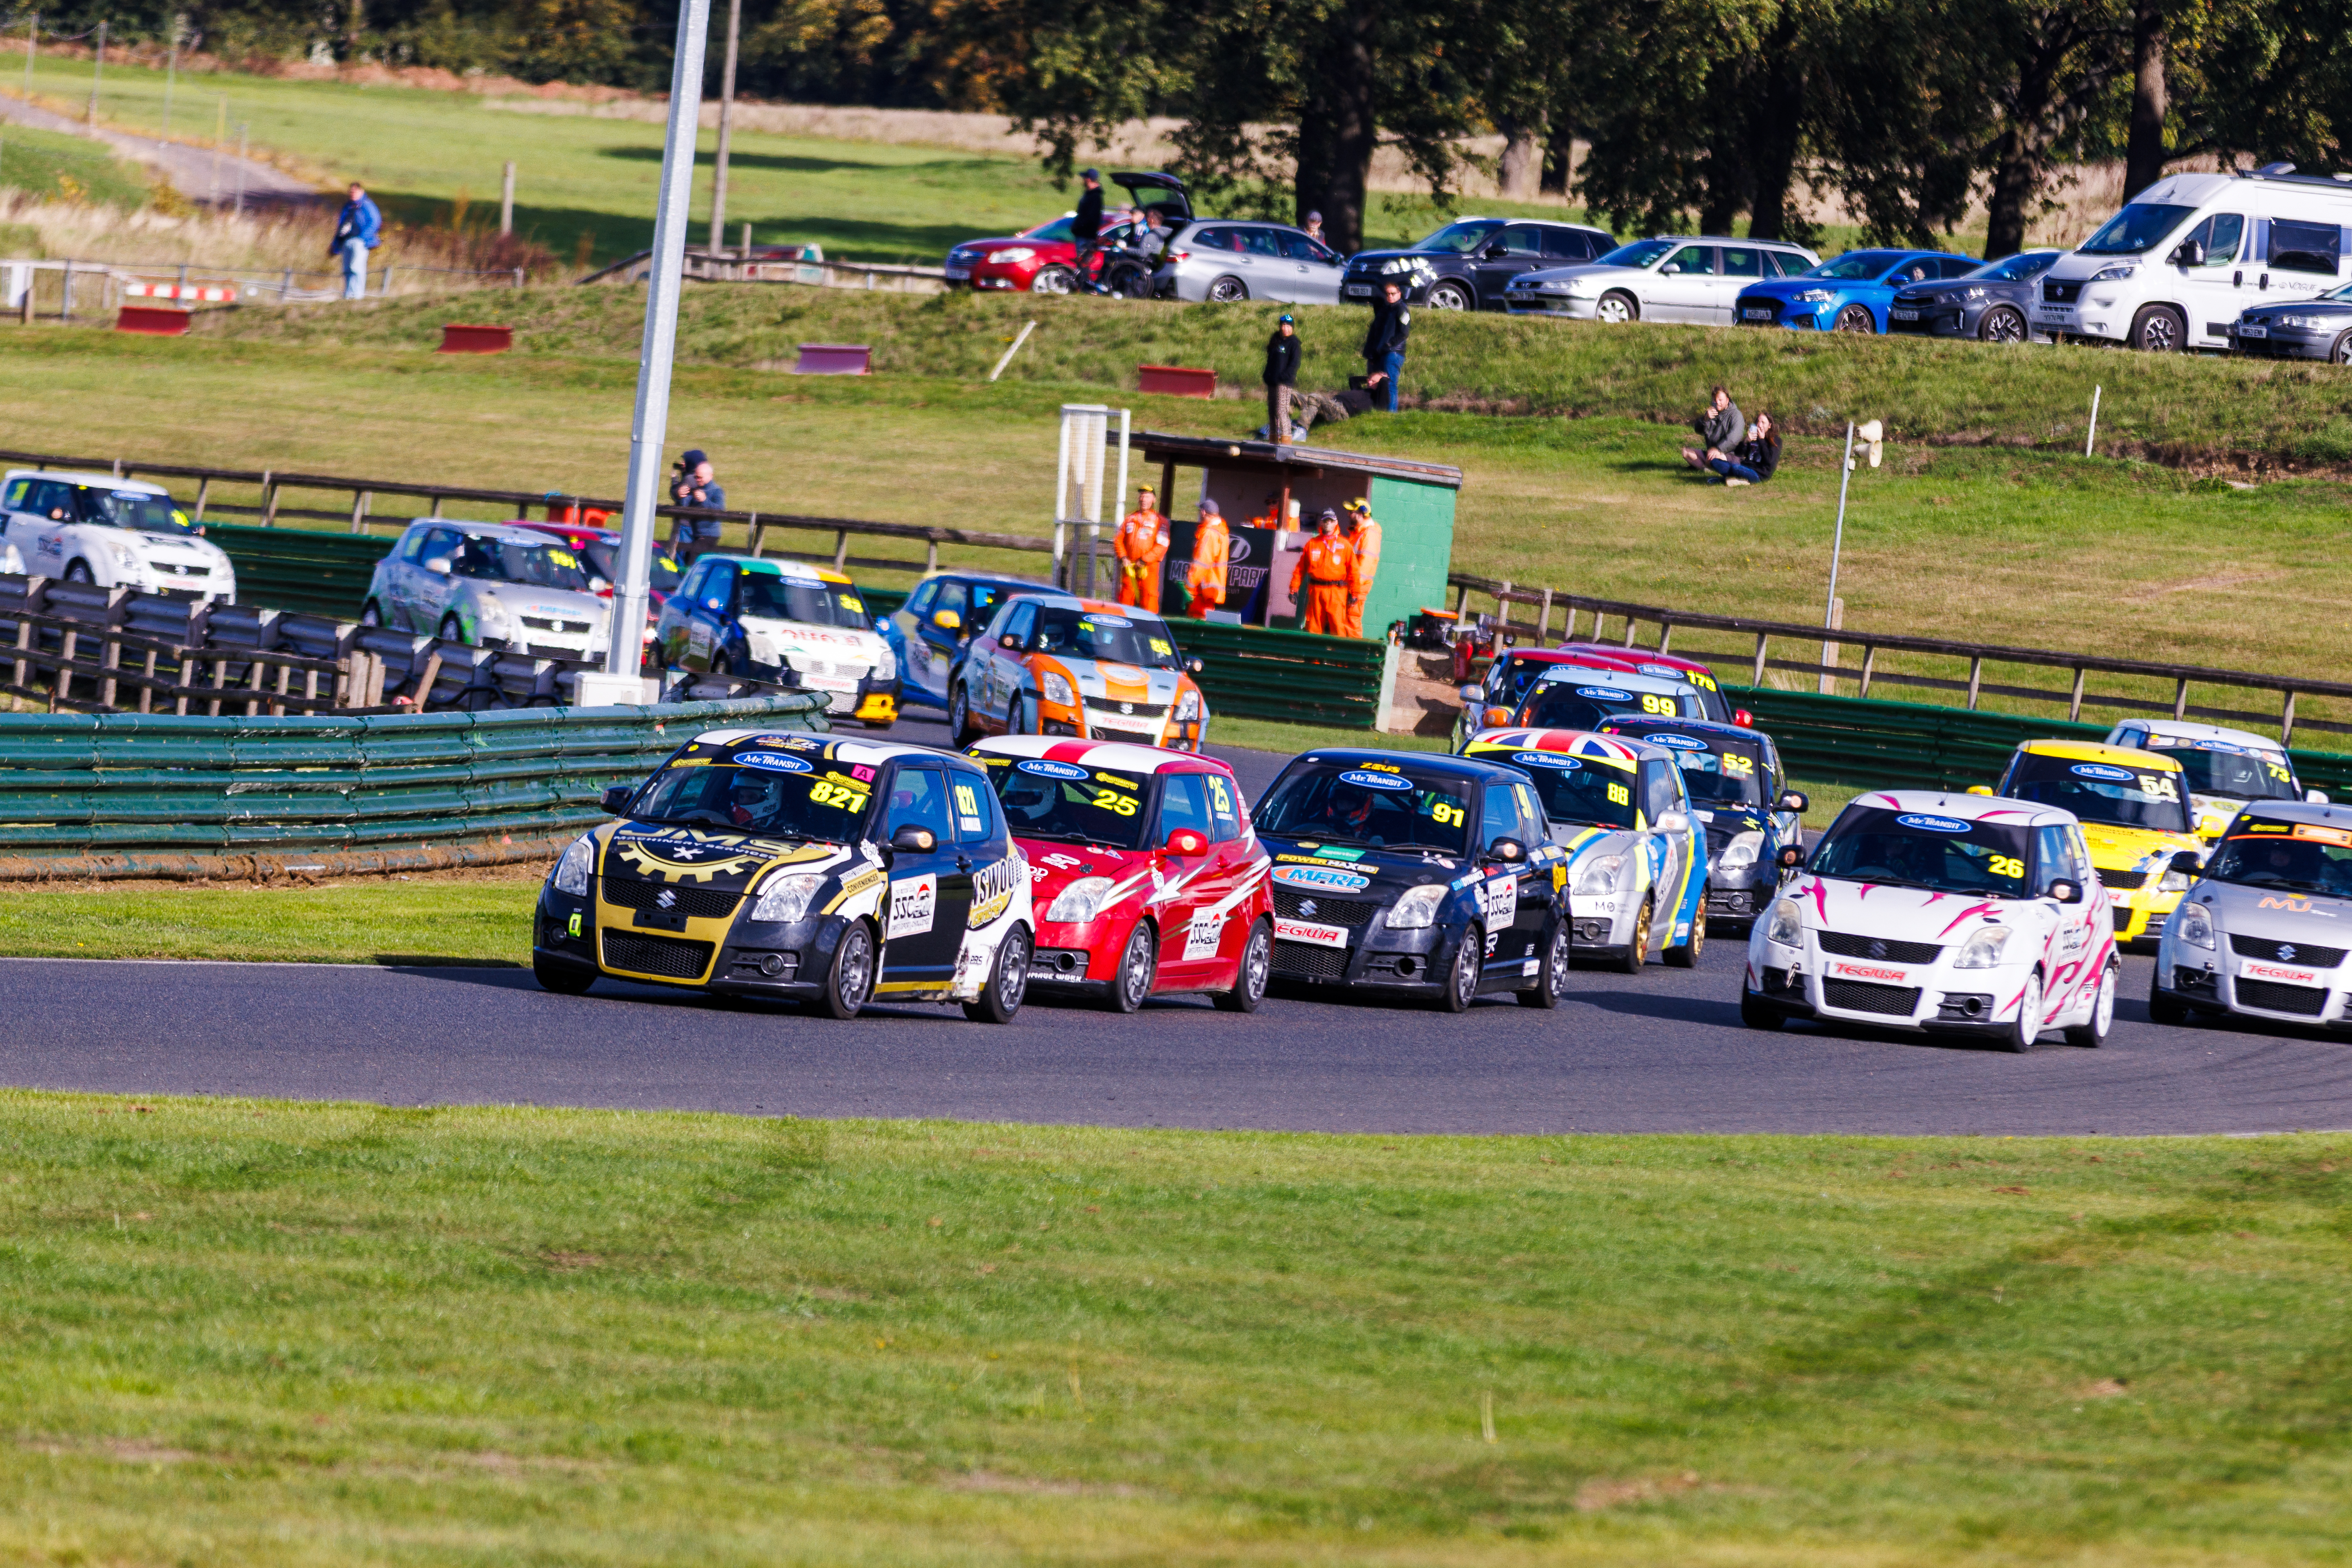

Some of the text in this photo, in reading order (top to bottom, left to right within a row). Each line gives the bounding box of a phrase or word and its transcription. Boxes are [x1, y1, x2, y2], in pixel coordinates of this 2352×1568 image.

[2289, 282, 2317, 292] VOGUE
[1149, 638, 1172, 656] 85
[1687, 670, 1716, 692] 179
[1642, 694, 1676, 717] 99
[1102, 717, 1149, 729] TEGIWA
[762, 755, 802, 770] TRANSIT
[1043, 763, 1080, 778] TRANSIT
[1360, 762, 1401, 773] ZEUS
[1537, 755, 1572, 766] TRANSIT
[1723, 753, 1753, 774] 52
[858, 769, 868, 778] A
[1365, 774, 1403, 787] TRANSIT
[2094, 767, 2125, 778] TRANSIT
[2266, 762, 2291, 783] 73
[1208, 776, 1230, 813] 25
[1607, 782, 1629, 806] 88
[2138, 775, 2177, 798] 54
[810, 781, 866, 814] 821
[955, 785, 978, 815] 821
[1092, 790, 1139, 816] 25
[1432, 803, 1464, 828] 91
[1924, 817, 1961, 830] TRANSIT
[614, 836, 778, 860] MACHINERY SERVICES
[1988, 855, 2025, 878] 26
[847, 873, 879, 894] CONVENIENCES
[2258, 897, 2312, 913] MJ
[1835, 962, 1908, 982] TEGIWA
[2248, 964, 2315, 982] TEGIWA
